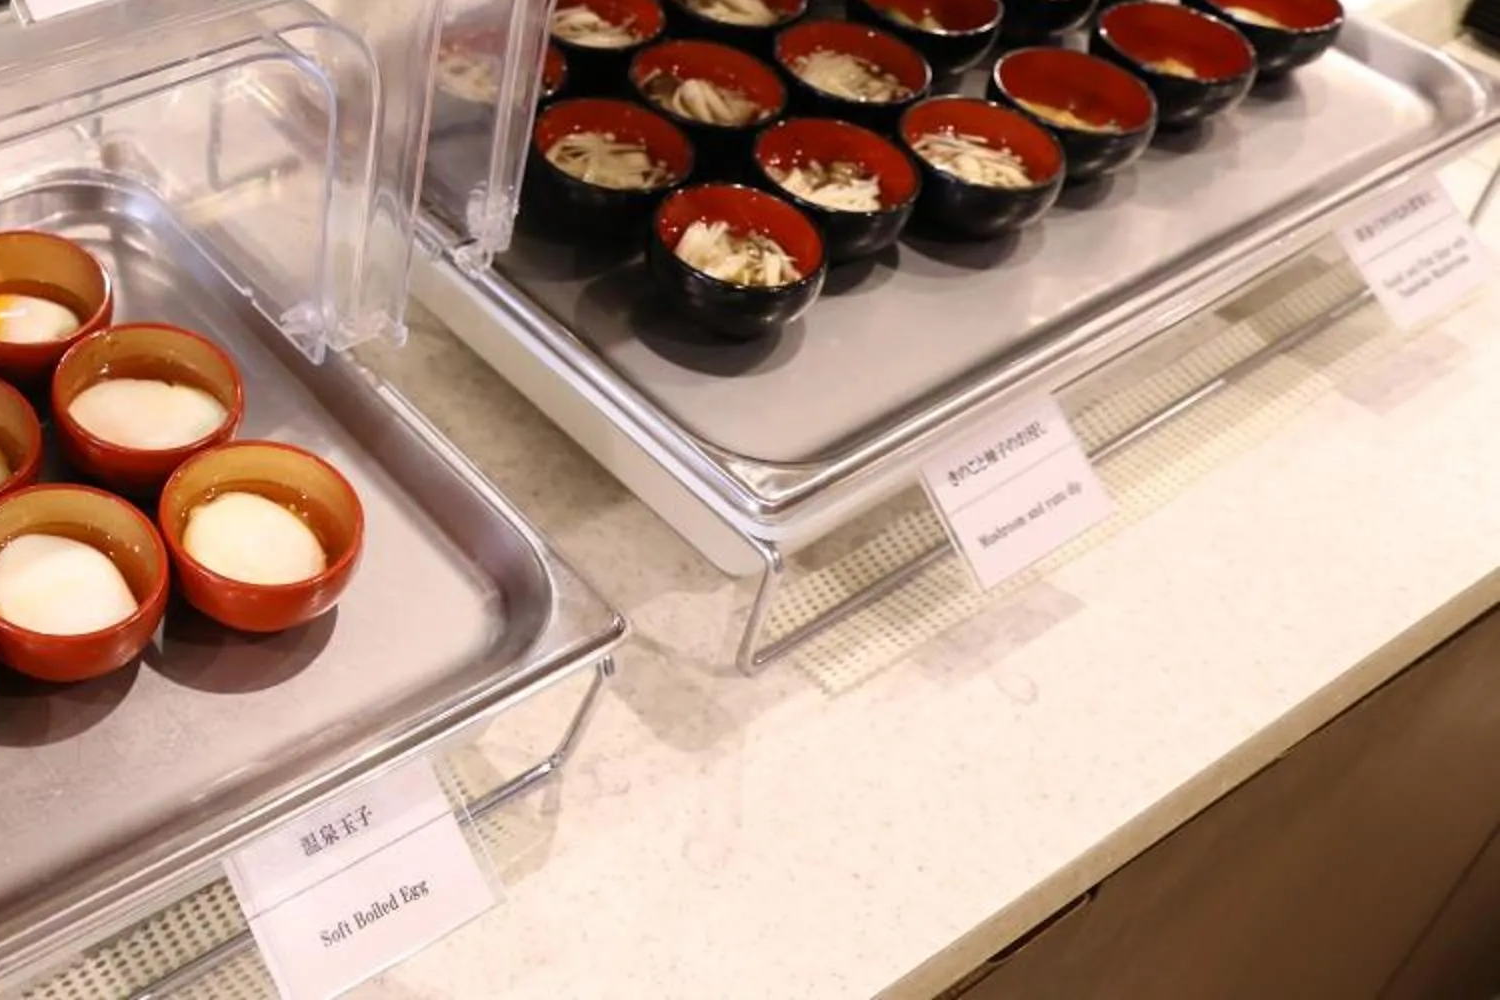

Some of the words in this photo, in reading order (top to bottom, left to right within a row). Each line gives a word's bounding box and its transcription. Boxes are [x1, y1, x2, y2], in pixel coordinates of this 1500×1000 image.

[300, 804, 373, 857] 温泉玉子
[320, 922, 353, 948] Soft
[353, 893, 400, 930] Boiled
[399, 880, 429, 904] Egg
